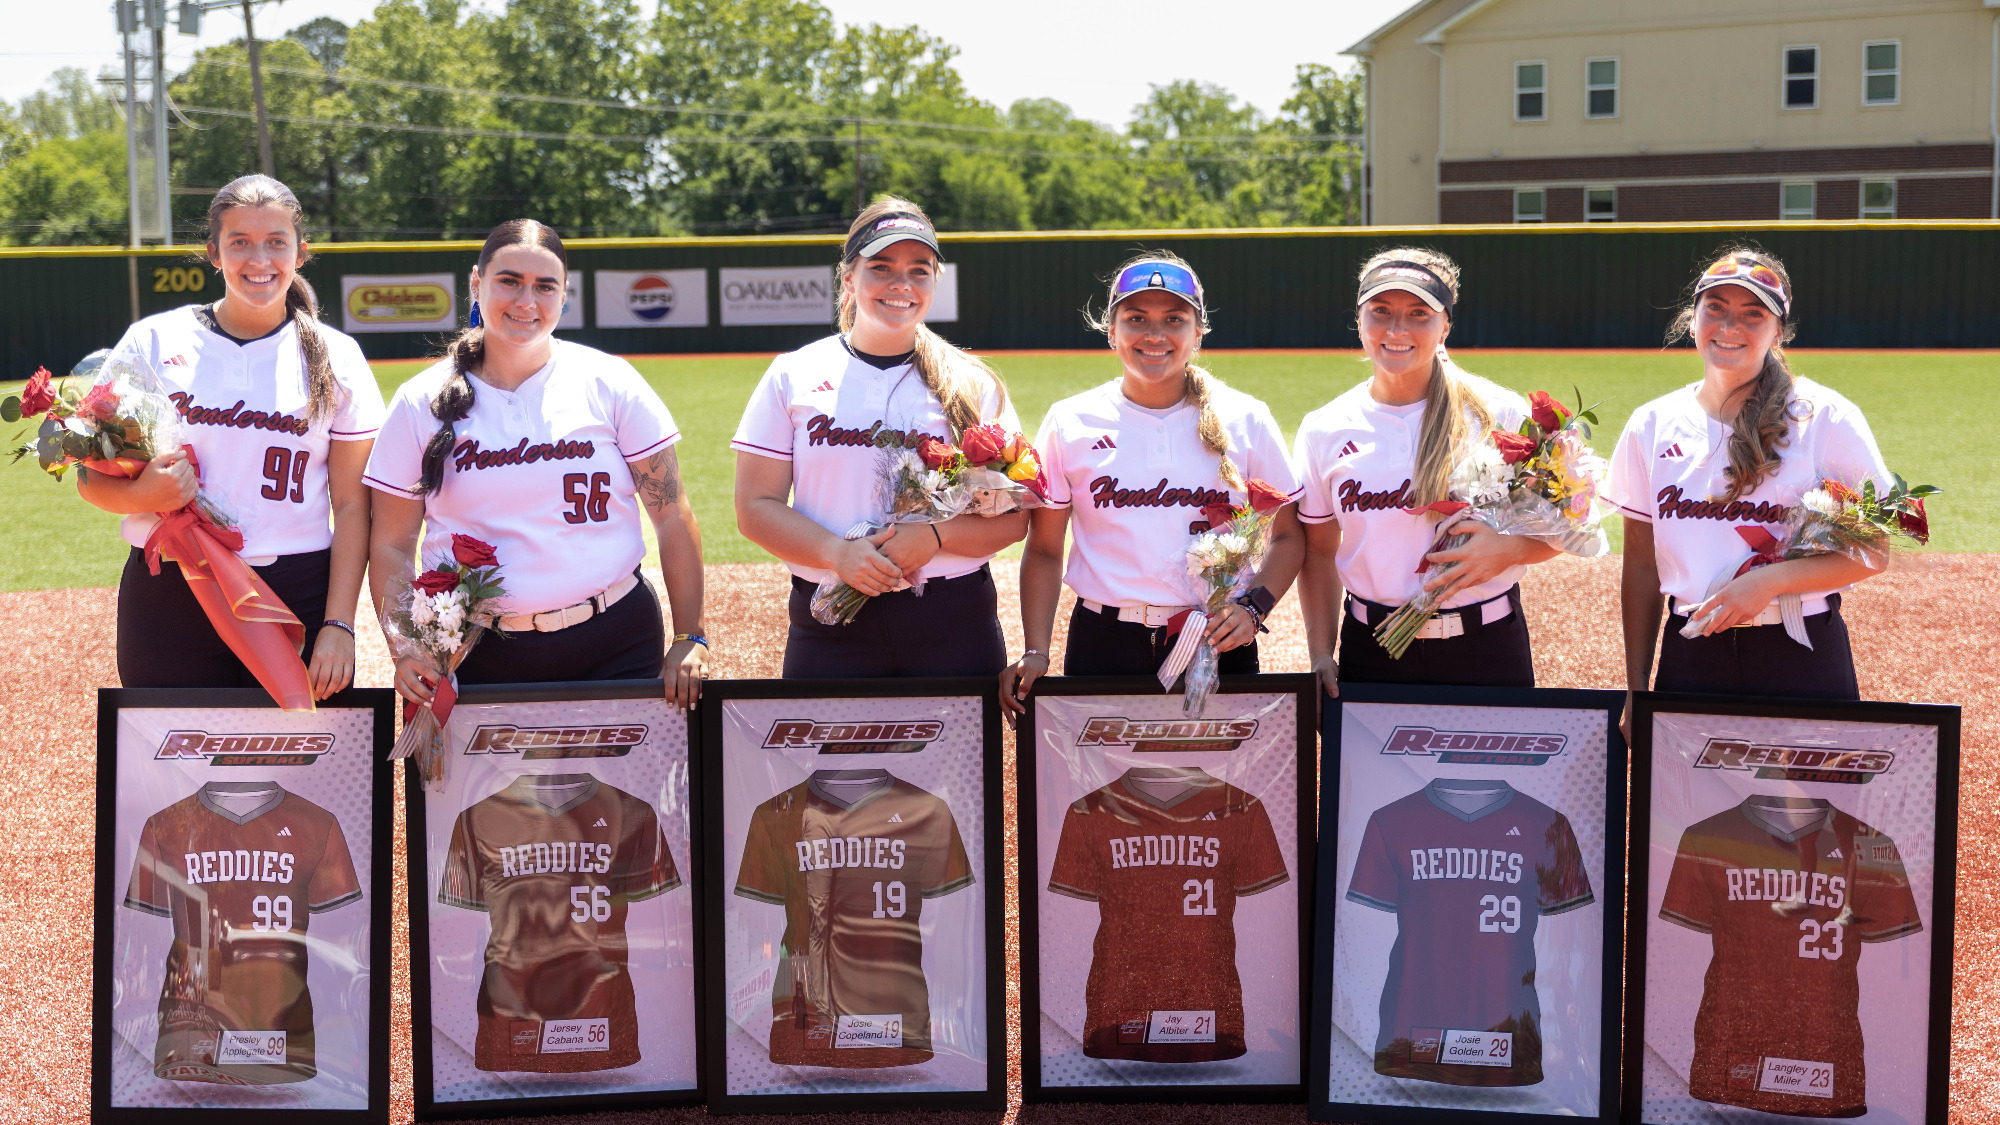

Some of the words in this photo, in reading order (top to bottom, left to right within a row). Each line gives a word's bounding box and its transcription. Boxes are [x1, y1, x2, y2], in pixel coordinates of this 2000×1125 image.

[153, 267, 205, 292] 200
[724, 279, 828, 302] OAKLAWN
[629, 292, 672, 304] PEPSI
[168, 391, 309, 436] Henderson
[453, 437, 595, 473] Henderson
[261, 446, 310, 503] 99
[563, 472, 610, 524] 56
[468, 727, 646, 751] REDDIES
[766, 721, 942, 745] REDDIES
[1080, 719, 1257, 743] REDDIES
[1385, 728, 1565, 753] REDDIES
[158, 731, 334, 757] REDDIES
[830, 743, 913, 753] SOFTBALL
[221, 755, 305, 765] SOFTBALL
[1449, 753, 1536, 765] SOFTBALL
[1698, 740, 1893, 772] REDDIES
[1766, 769, 1860, 784] SOFTBALL
[499, 841, 612, 877] REDDIES
[795, 837, 905, 871] REDDIES
[1109, 835, 1220, 869] REDDIES
[184, 850, 295, 884] REDDIES
[1410, 847, 1524, 884] REDDIES
[872, 881, 906, 918] 19
[1182, 879, 1217, 916] 21
[1725, 868, 1846, 908] REDDIES
[252, 895, 292, 932] 99
[570, 885, 611, 923] 56
[1479, 894, 1521, 934] 29
[1798, 918, 1844, 960] 23
[551, 1024, 582, 1034] Jersey
[848, 1019, 873, 1028] Josie
[884, 1019, 900, 1039] 19
[1158, 1026, 1189, 1035] Albiter
[1165, 1015, 1183, 1024] Jay
[1194, 1016, 1211, 1034] 21
[229, 1035, 262, 1046] Presley
[547, 1035, 584, 1045] Cabana
[588, 1023, 606, 1042] 56
[838, 1030, 883, 1041] Copeland
[1455, 1034, 1481, 1044] Josie
[222, 1047, 265, 1057] Applegate
[266, 1036, 285, 1055] 99
[1449, 1046, 1484, 1057] Golden
[1489, 1038, 1509, 1058] 29
[1768, 1062, 1809, 1075] Langley
[1773, 1074, 1802, 1086] Miller
[1808, 1068, 1830, 1088] 23
